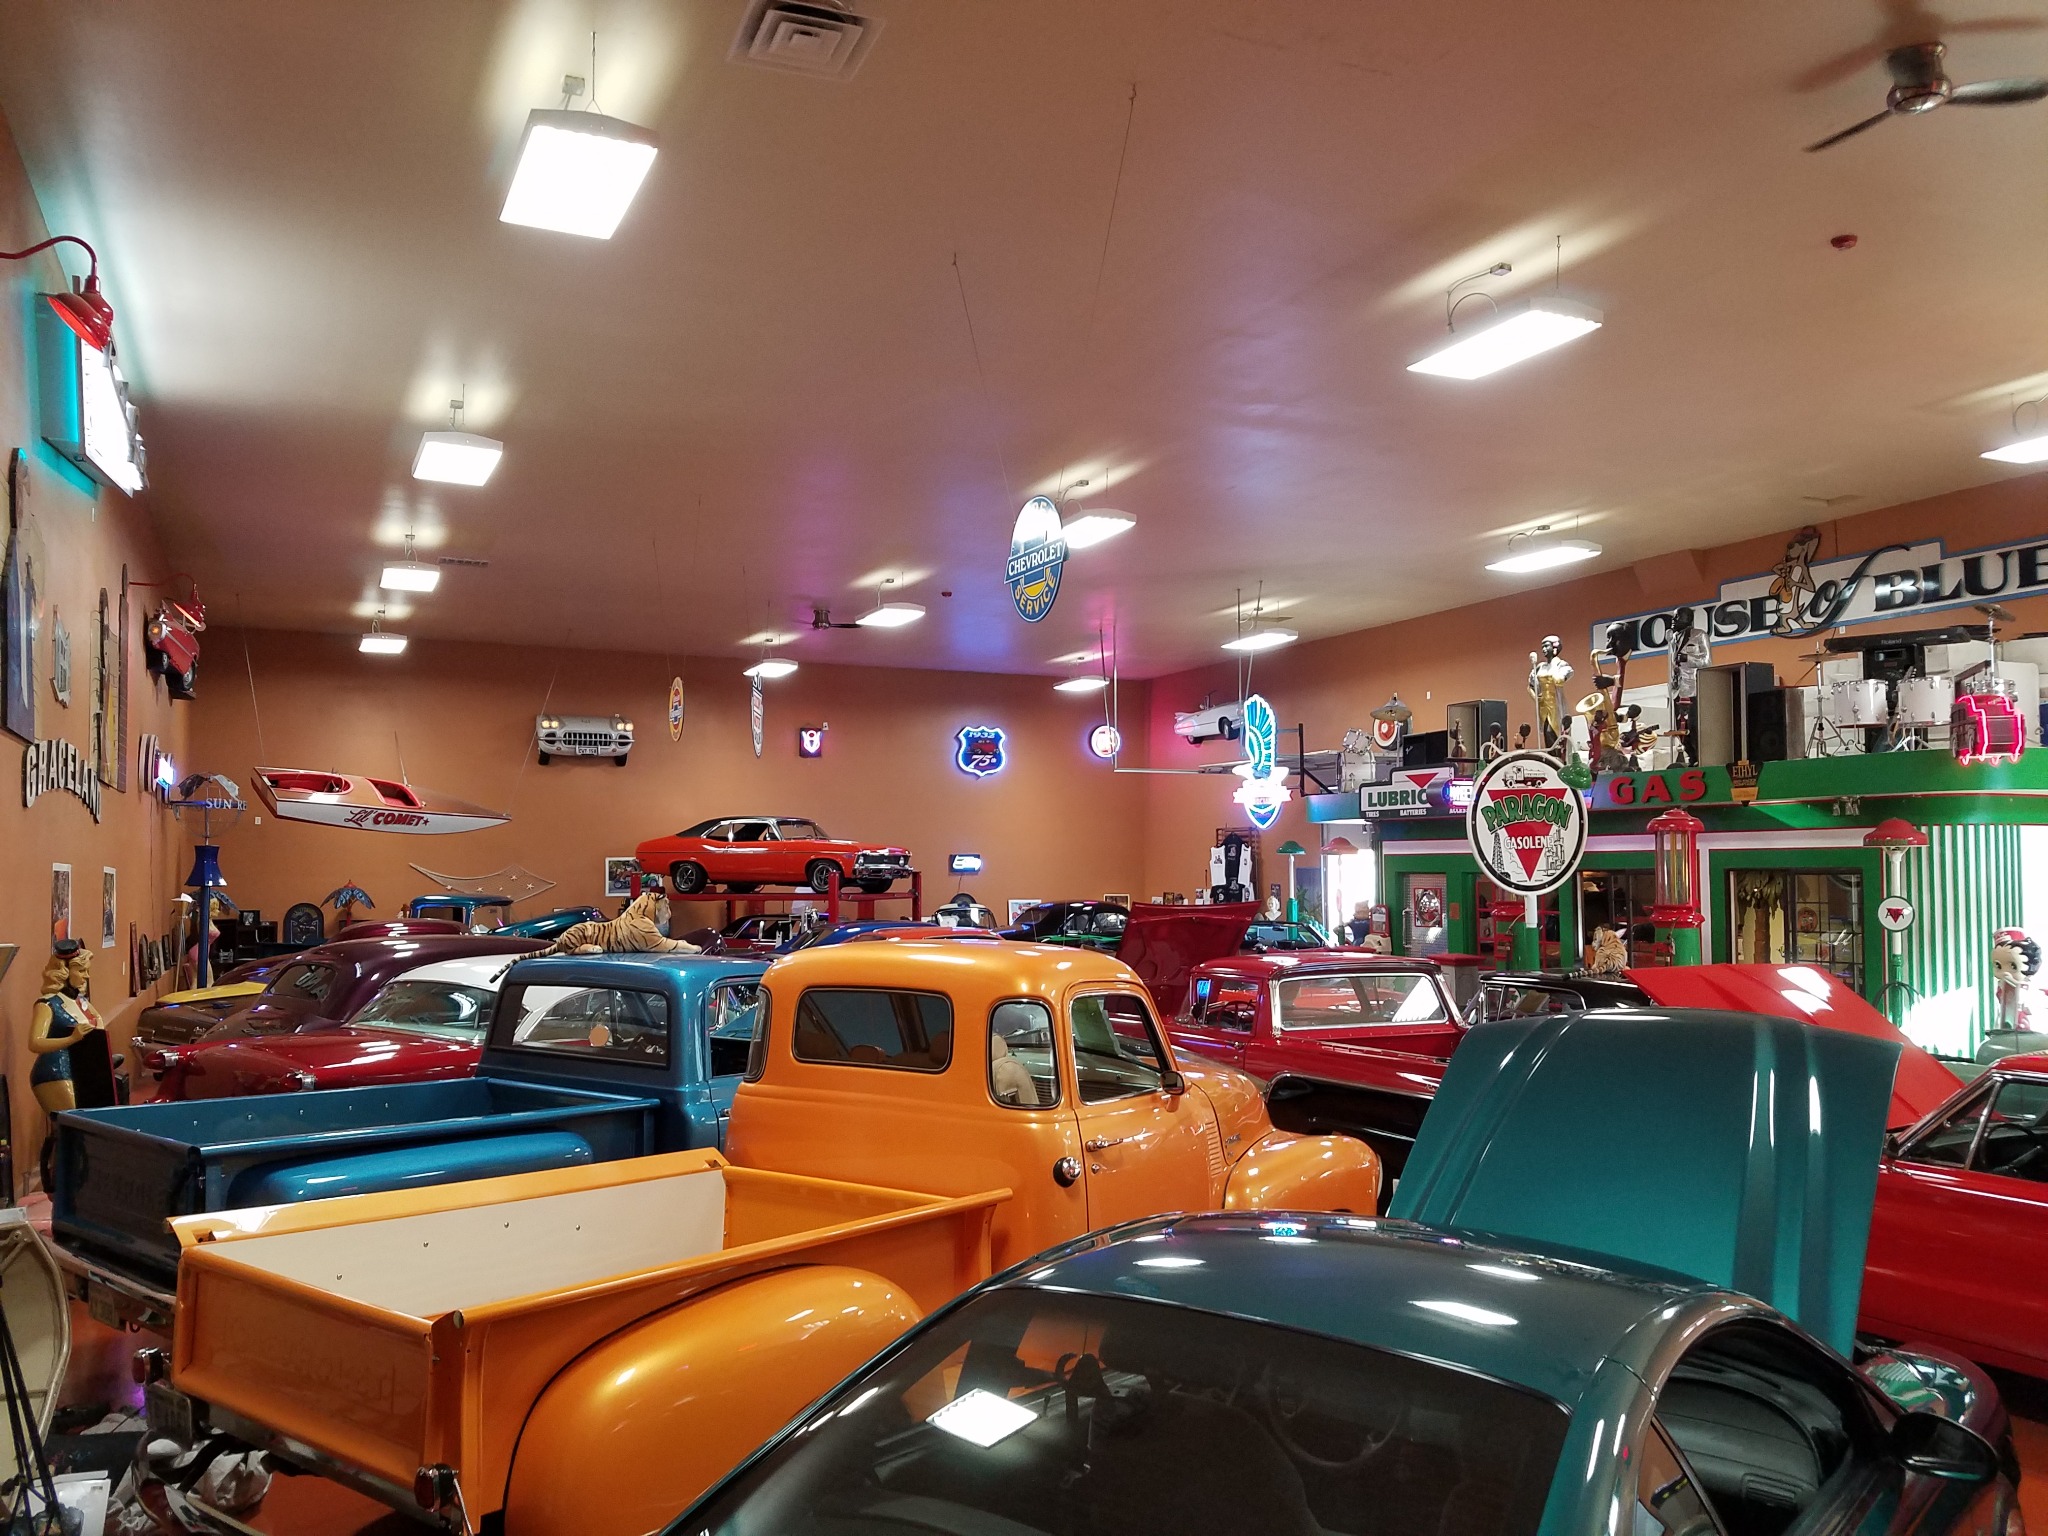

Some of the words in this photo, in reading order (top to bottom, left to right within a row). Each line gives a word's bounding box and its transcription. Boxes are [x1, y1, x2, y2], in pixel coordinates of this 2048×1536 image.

[1008, 541, 1063, 576] CHEVROLET
[1014, 570, 1056, 615] SERVICE
[1880, 638, 1903, 646] Roland
[968, 731, 996, 739] 1932
[1732, 764, 1758, 778] ETHYL
[24, 737, 102, 824] GRACELAND
[1608, 769, 1706, 806] GAS
[205, 797, 233, 810] SUN
[372, 812, 425, 827] COMET
[1399, 808, 1427, 817] BATTERIES
[1481, 793, 1574, 834] PARAGON
[1504, 835, 1554, 849] GASOLENE
